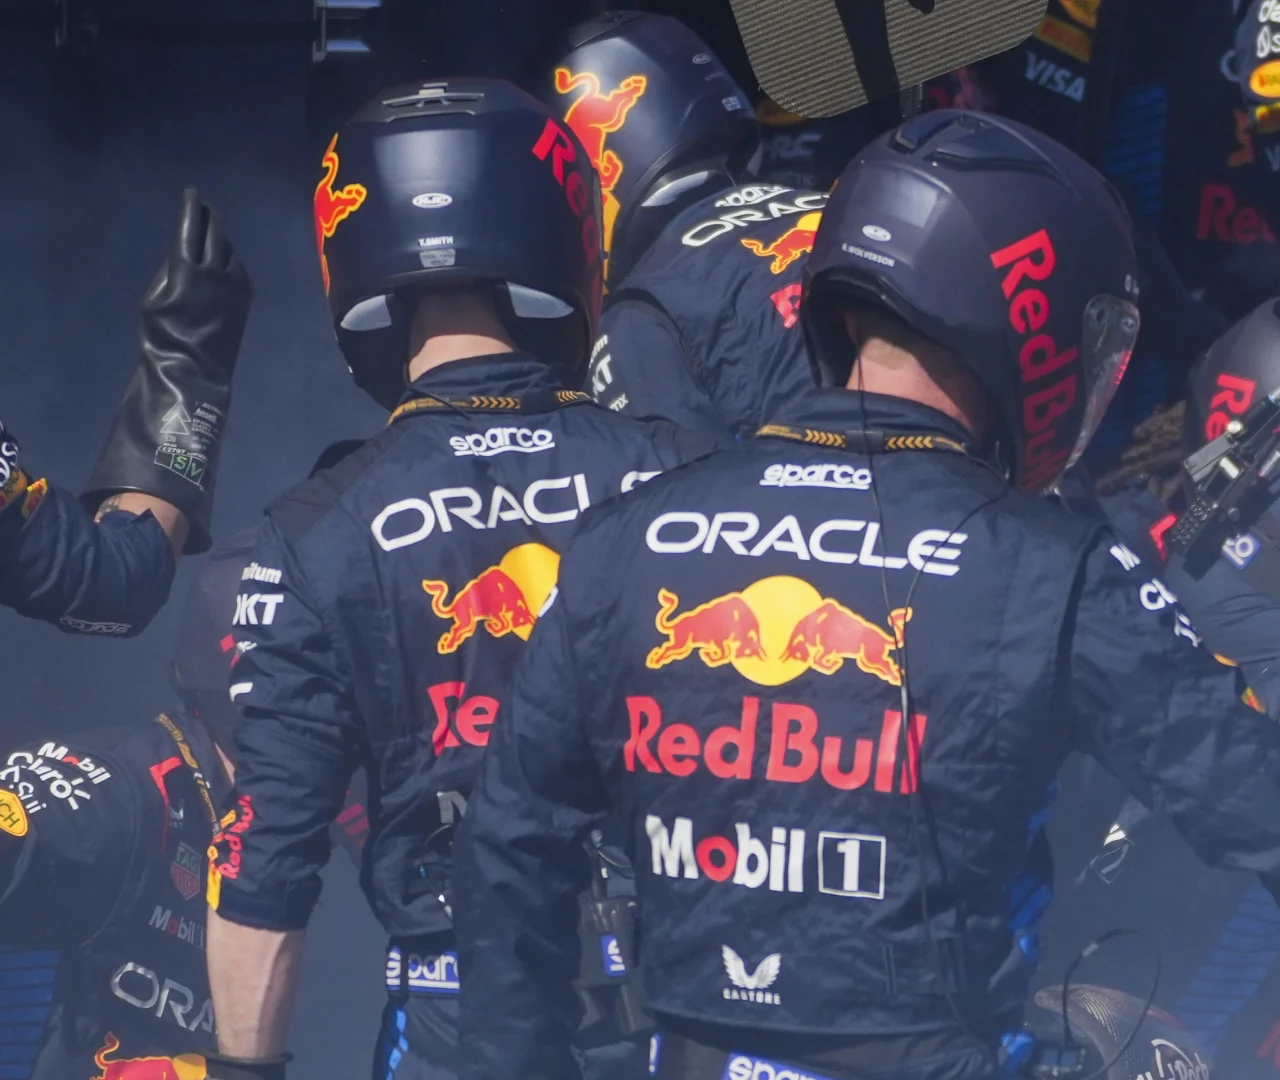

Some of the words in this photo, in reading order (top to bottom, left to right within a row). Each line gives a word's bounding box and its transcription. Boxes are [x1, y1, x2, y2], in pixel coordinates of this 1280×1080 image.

[1025, 49, 1085, 102] VISA
[450, 426, 556, 456] sparco
[761, 463, 873, 490] sparco
[645, 511, 969, 576] ORACLE
[645, 815, 805, 893] Mobil
[722, 987, 782, 1005] CASTORE
